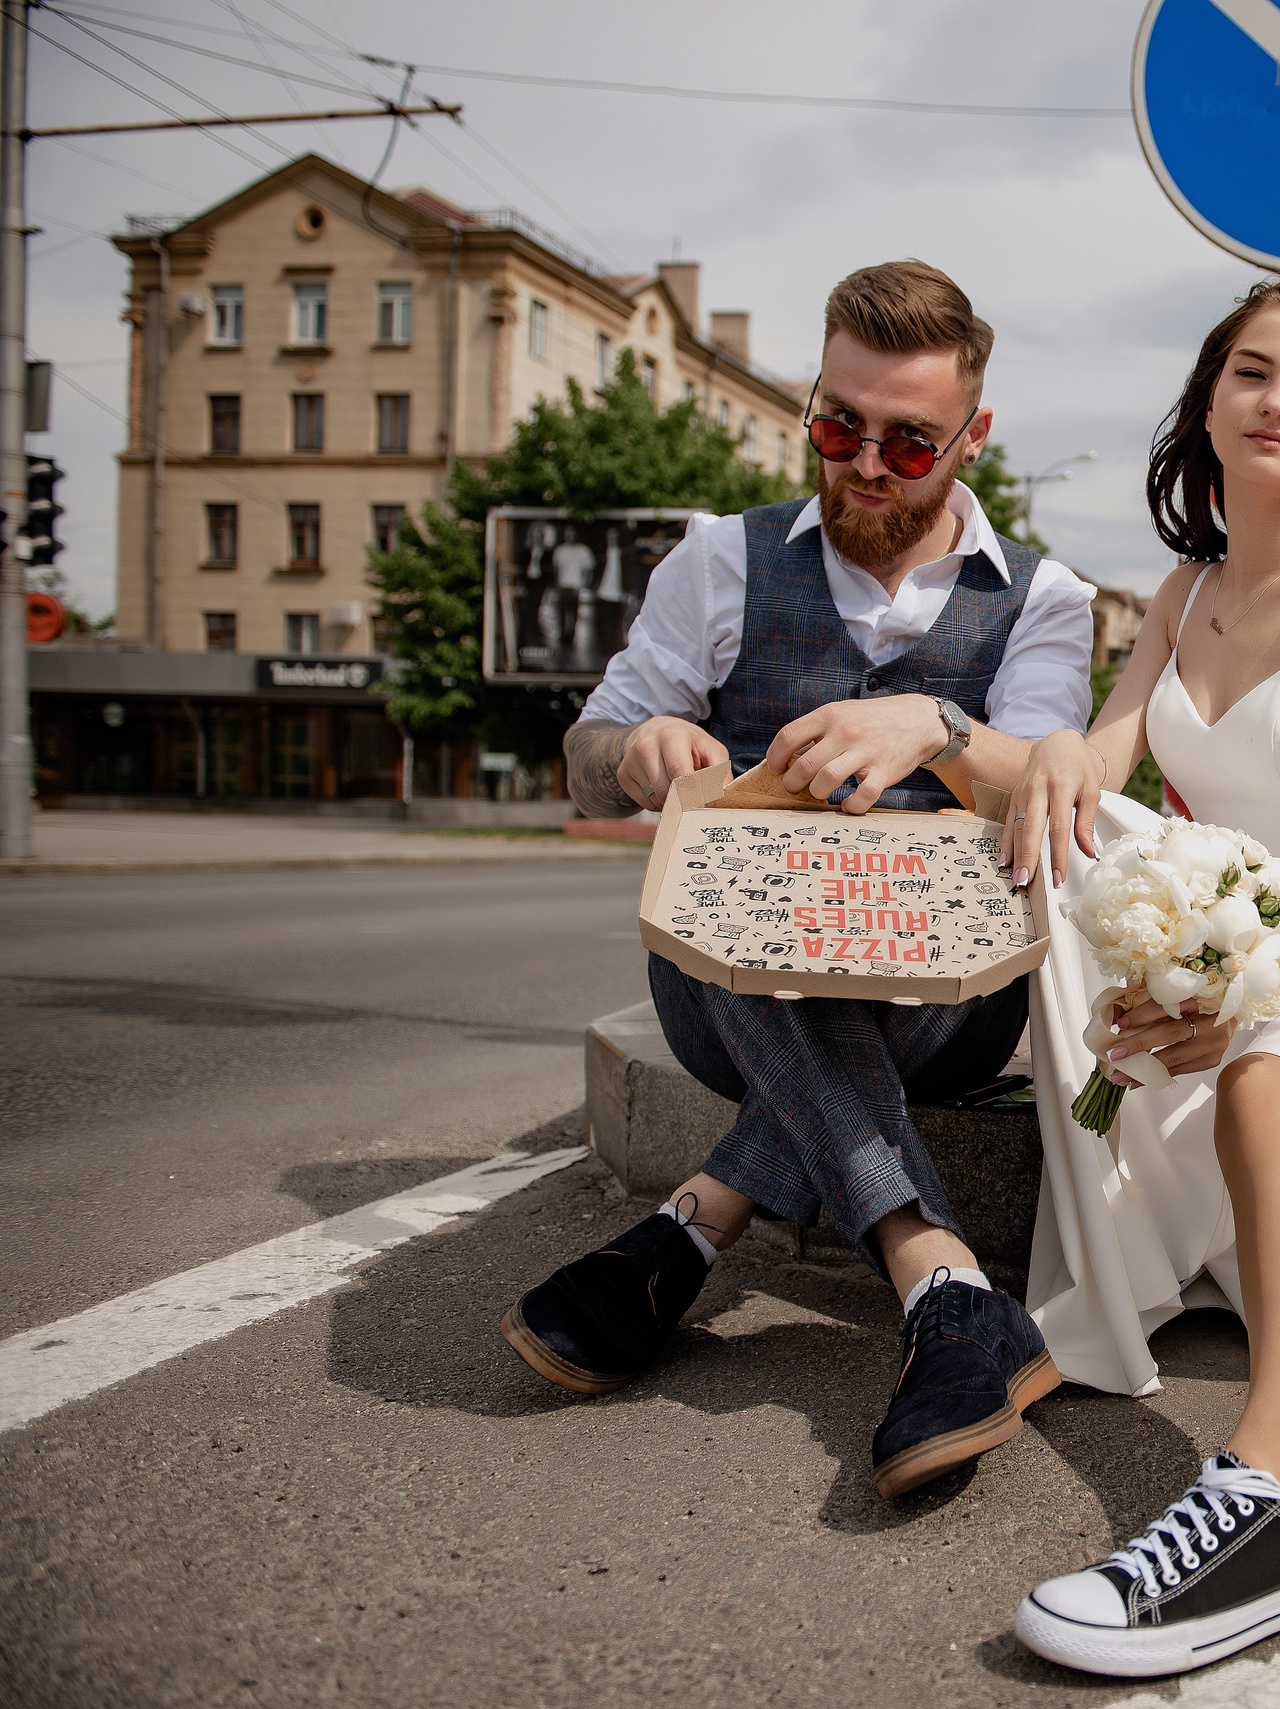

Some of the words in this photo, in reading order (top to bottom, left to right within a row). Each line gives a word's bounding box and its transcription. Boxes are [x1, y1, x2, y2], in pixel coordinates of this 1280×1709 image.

[787, 851, 927, 874] WORLD
[821, 879, 897, 901] THE
[794, 907, 928, 931] RULES
[802, 939, 926, 962] PIZZA
